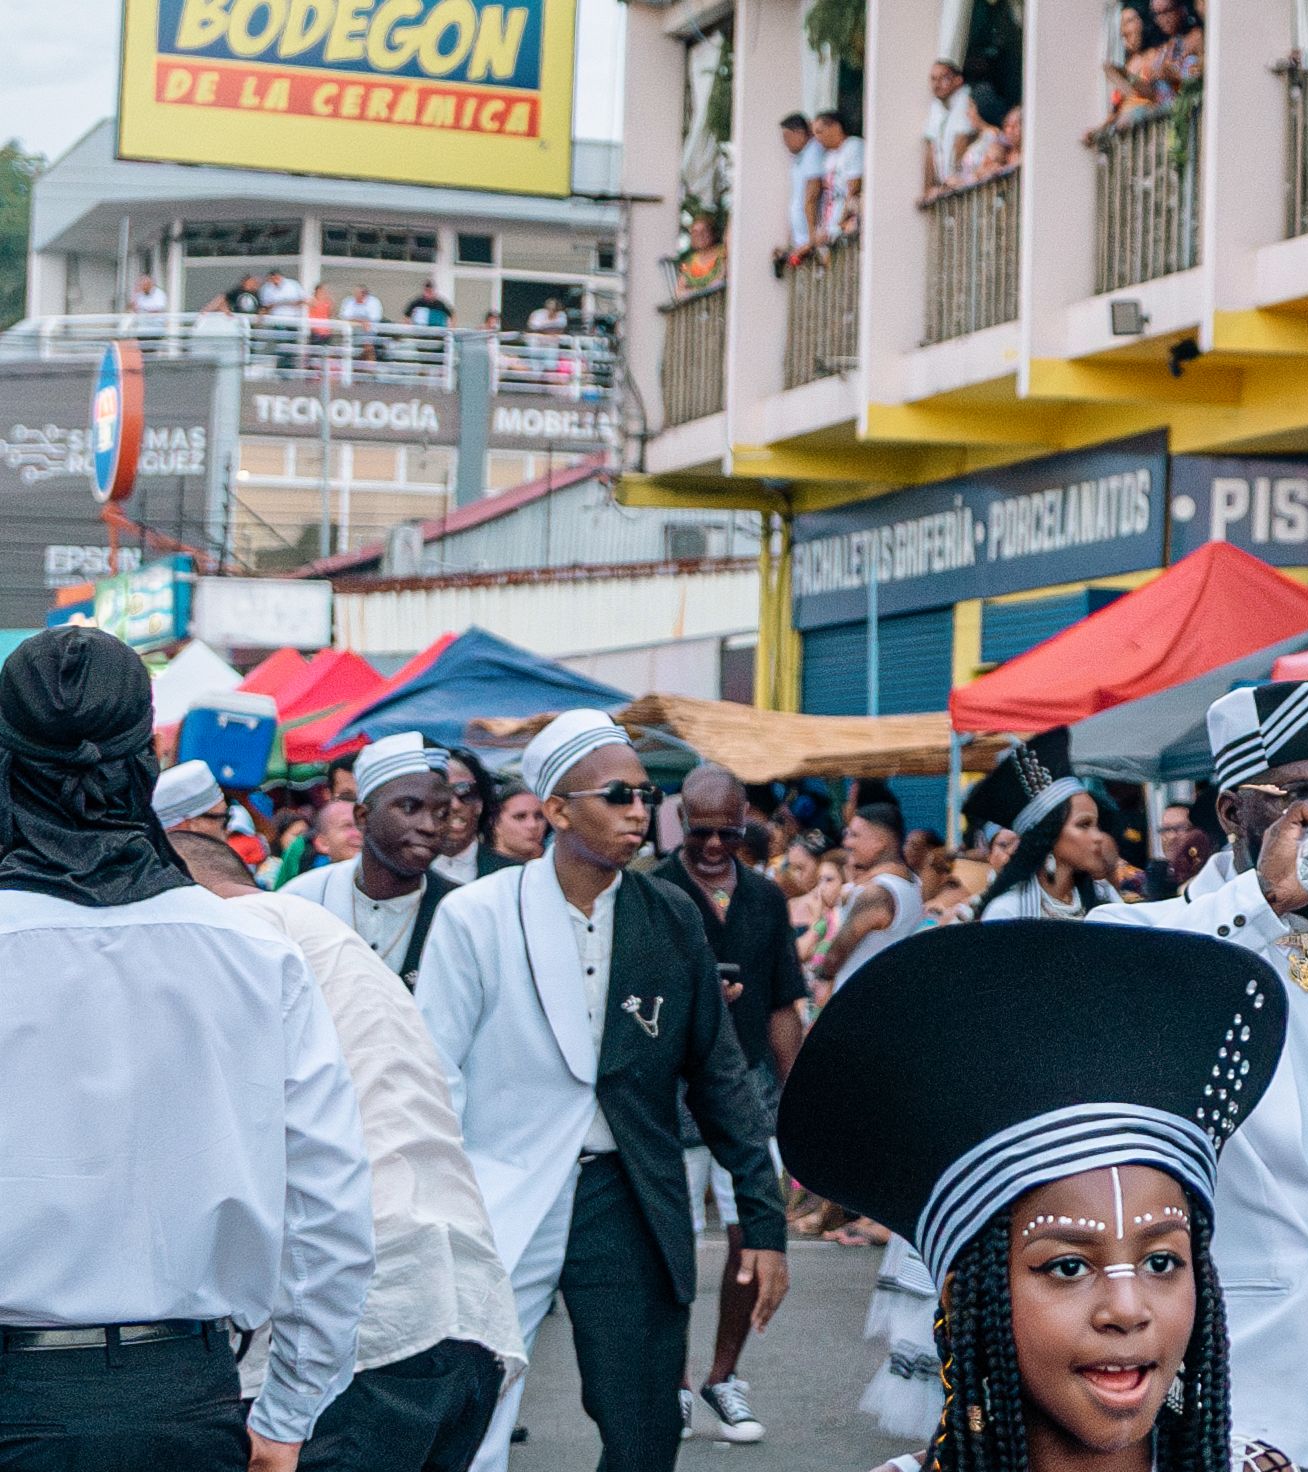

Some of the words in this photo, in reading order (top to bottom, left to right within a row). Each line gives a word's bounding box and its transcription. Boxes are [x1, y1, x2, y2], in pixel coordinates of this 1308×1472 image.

[163, 68, 220, 101] DE
[241, 75, 292, 111] LA
[254, 393, 440, 433] TECNOLOGÍA
[987, 468, 1151, 562] PORCELANATOS
